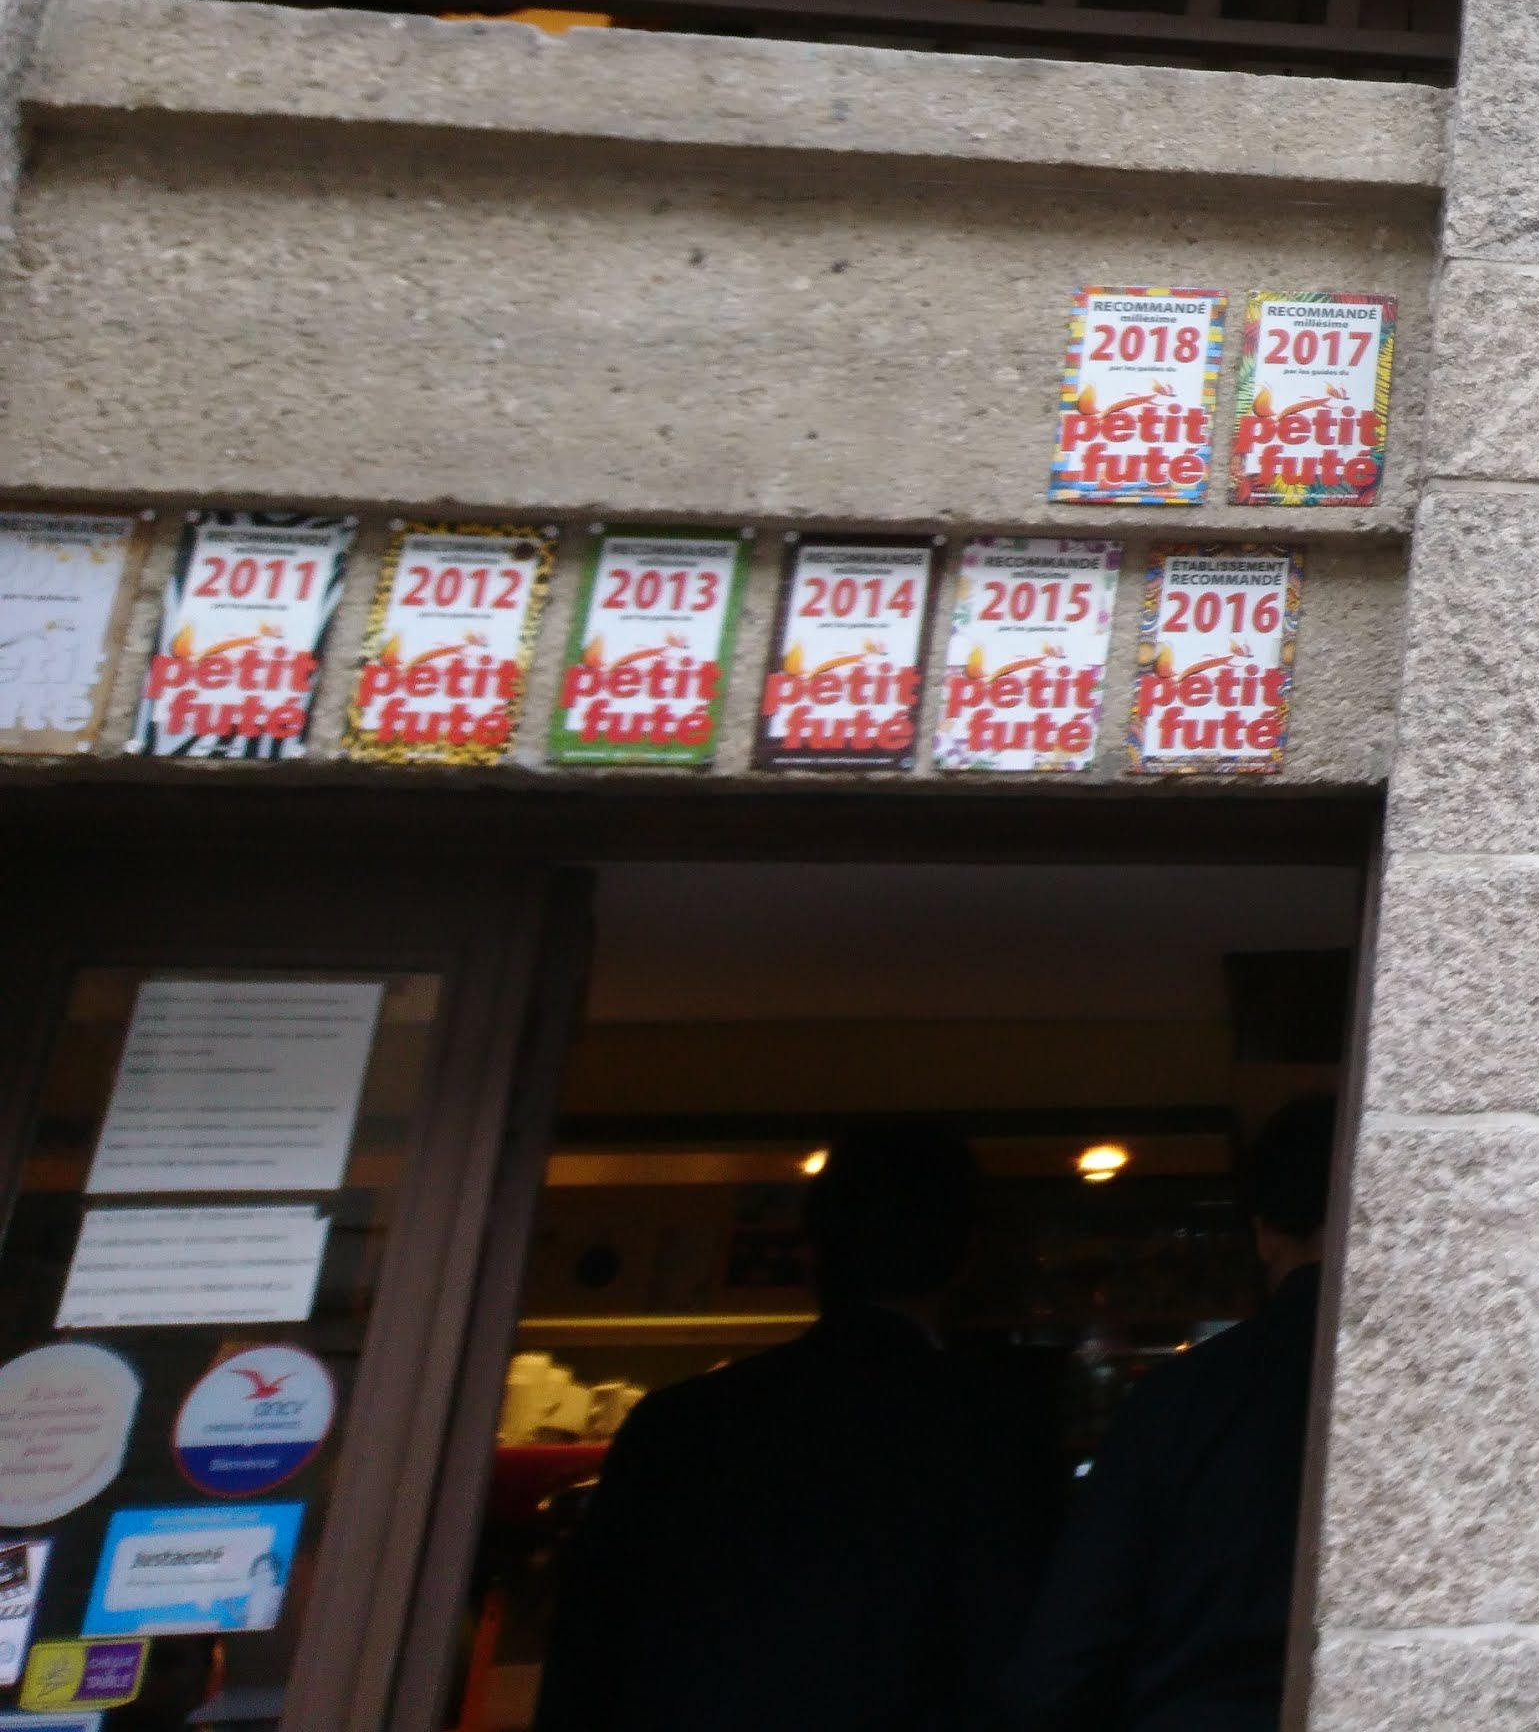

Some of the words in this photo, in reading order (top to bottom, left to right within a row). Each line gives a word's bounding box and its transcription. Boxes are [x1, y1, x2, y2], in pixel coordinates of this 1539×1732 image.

[1093, 300, 1206, 315] RECOMMANDÉ
[1267, 305, 1377, 319] RECOMMANDÉ
[1089, 324, 1200, 363] 2018
[1264, 329, 1373, 366] 2017
[1060, 404, 1210, 452] petit
[1231, 406, 1382, 454] petit
[1081, 442, 1205, 484] futé
[1258, 444, 1377, 486] futé
[193, 556, 318, 601] 2011
[402, 566, 523, 609] 2012
[603, 569, 720, 611] 2013
[798, 577, 916, 619] 2014
[1170, 571, 1283, 586] RECOMMANDÉ
[977, 581, 1093, 622] 2015
[1162, 591, 1281, 634] 2016
[145, 646, 319, 699] petit
[357, 655, 520, 707] petit
[560, 656, 723, 708] petit
[760, 662, 921, 717] petit
[945, 665, 1098, 718] petit
[1138, 664, 1286, 716] petit
[166, 689, 308, 739] futé
[377, 697, 512, 746] futé
[580, 699, 714, 745] futé
[782, 705, 915, 750] futé
[967, 708, 1093, 753] futé
[1158, 707, 1283, 750] futé
